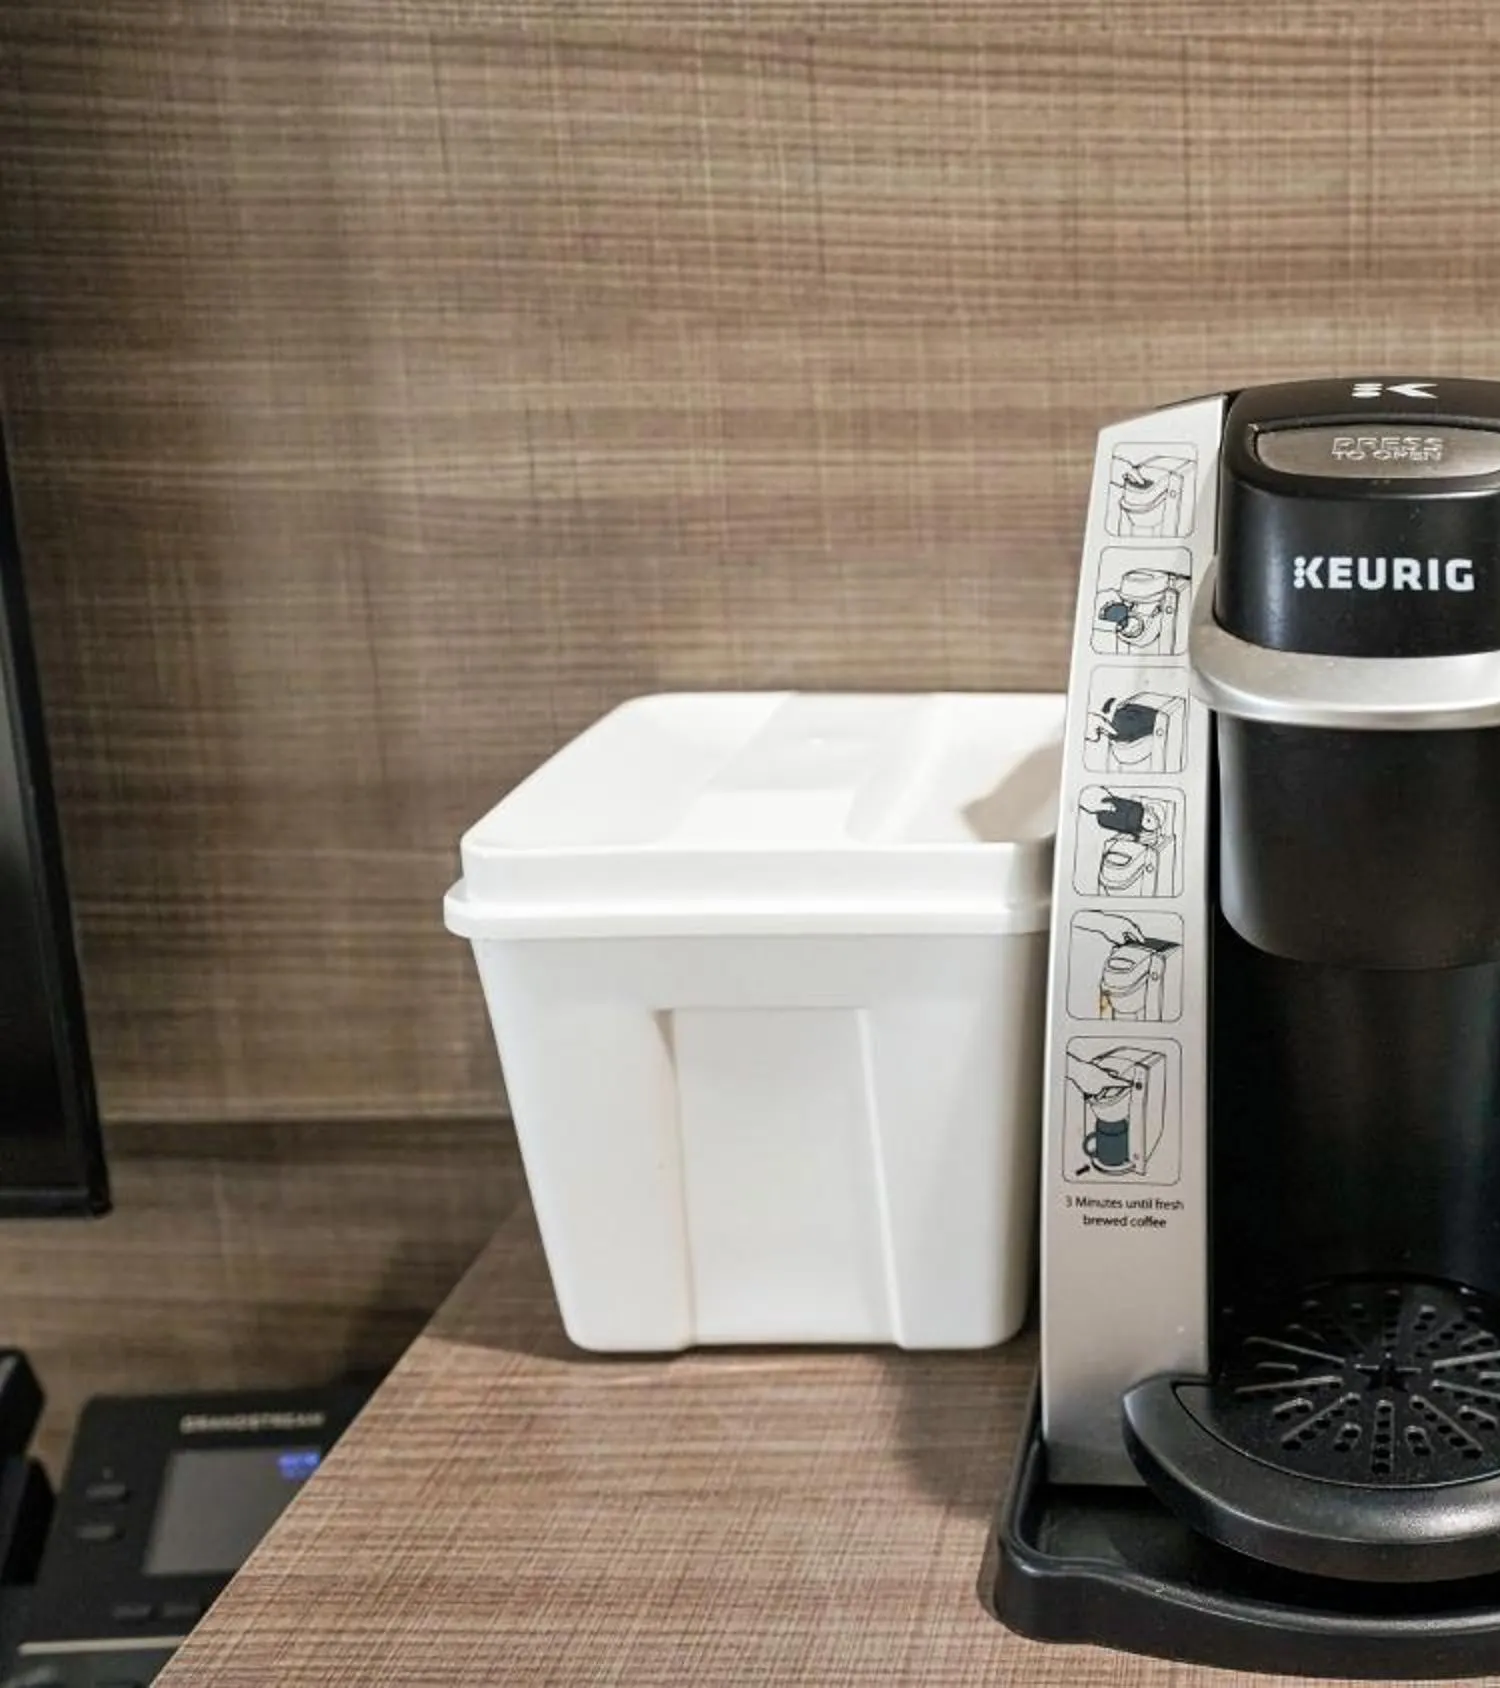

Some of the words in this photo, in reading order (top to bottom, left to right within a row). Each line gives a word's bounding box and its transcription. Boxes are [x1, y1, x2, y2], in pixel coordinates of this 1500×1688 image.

[1333, 436, 1444, 451] PRESS
[1331, 450, 1366, 461] TO
[1372, 449, 1442, 462] OPEN
[1293, 556, 1475, 592] KEURIG
[1065, 1195, 1073, 1209] 3
[1075, 1196, 1123, 1209] Minutes
[1125, 1197, 1153, 1210] until
[1155, 1197, 1185, 1211] fresh
[1083, 1213, 1128, 1227] brewed
[1130, 1215, 1167, 1229] coffee
